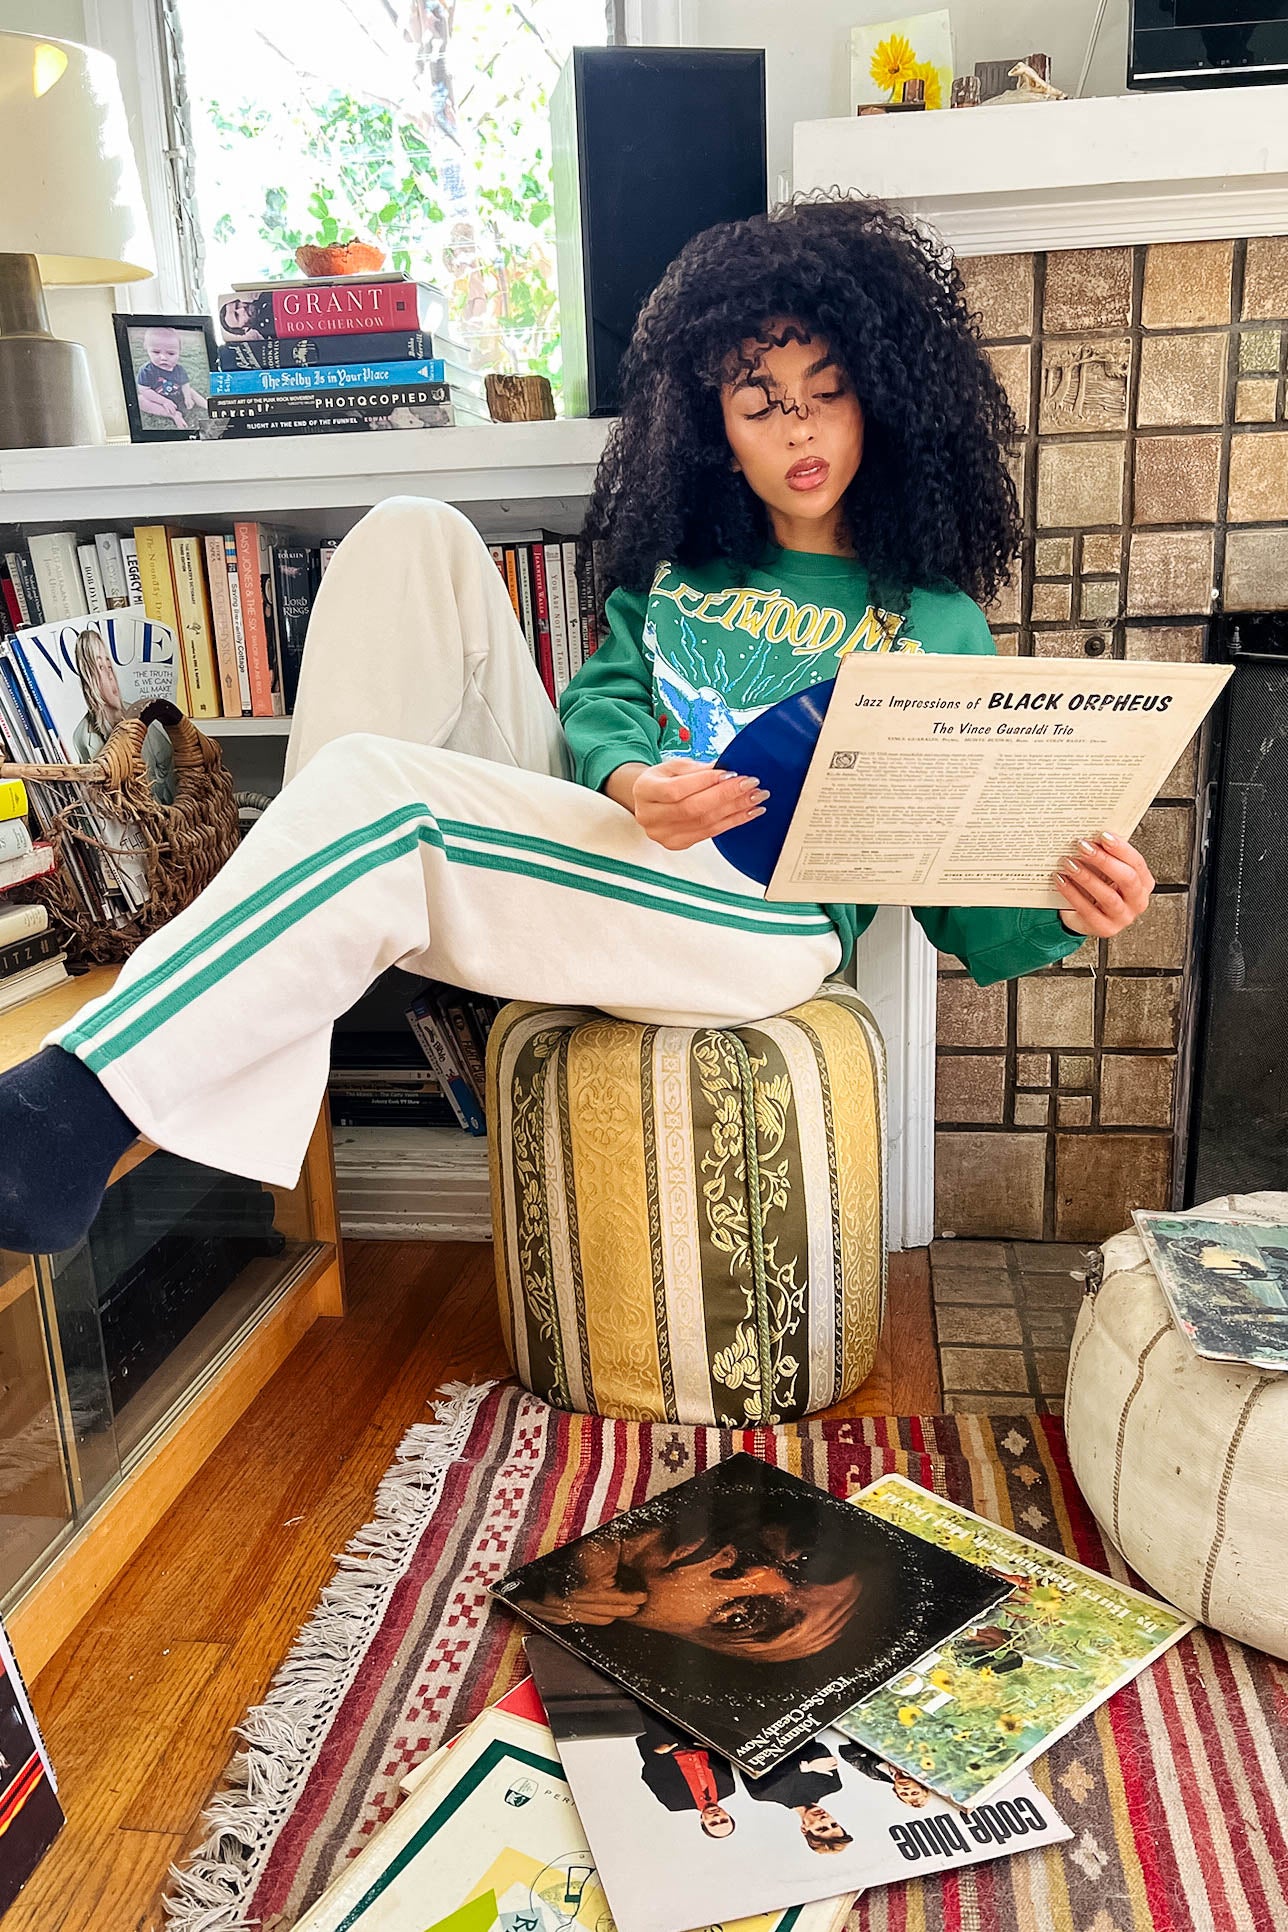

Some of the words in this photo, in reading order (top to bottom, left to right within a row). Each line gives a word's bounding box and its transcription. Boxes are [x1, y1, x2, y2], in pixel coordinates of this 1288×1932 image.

[283, 288, 383, 315] GRANT
[287, 320, 313, 333] RON
[317, 316, 384, 330] CHERNOW
[224, 373, 232, 393] Selby
[259, 371, 281, 390] The
[281, 371, 311, 389] Selby
[314, 371, 325, 386] Is
[327, 371, 337, 384] in
[337, 370, 362, 386] Your
[362, 367, 390, 383] Place
[319, 418, 331, 426] THE
[332, 417, 358, 425] FUNNEL
[240, 526, 248, 554] DAISY
[9, 560, 18, 580] THE
[85, 566, 94, 584] BOB
[127, 554, 142, 592] LEGACY
[148, 552, 162, 598] Noonday
[241, 556, 252, 588] JONES
[533, 551, 543, 590] JEANNETTE
[89, 587, 101, 613] DYLA
[246, 599, 255, 614] THE
[282, 606, 310, 618] RINGS
[284, 595, 308, 606] LORD
[537, 591, 545, 614] WALLS
[650, 558, 847, 656] LEETWOOD
[248, 617, 257, 631] SIX
[237, 646, 245, 674] Cottage
[154, 677, 173, 685] CAN
[855, 695, 882, 708] Jazz
[889, 696, 961, 711] Impressions
[966, 697, 982, 710] of
[987, 692, 1064, 710] BLACK
[1067, 694, 1174, 712] ORPHEUS
[932, 722, 954, 734] The
[960, 724, 991, 735] Vince
[996, 724, 1049, 736] Guaraldi
[1053, 725, 1074, 736] Trio
[880, 1492, 932, 1522] David
[933, 1515, 972, 1541] Hal
[973, 1535, 1079, 1593] Bacharach
[1079, 1588, 1131, 1619] Burt
[1136, 1615, 1159, 1633] by
[817, 1680, 844, 1698] Can
[799, 1694, 825, 1711] See
[761, 1708, 805, 1737] Clearly
[776, 1712, 822, 1748] Johnny
[736, 1733, 771, 1760] Now
[748, 1743, 786, 1766] Nash
[959, 1796, 1048, 1845] code
[888, 1813, 972, 1861] blue
